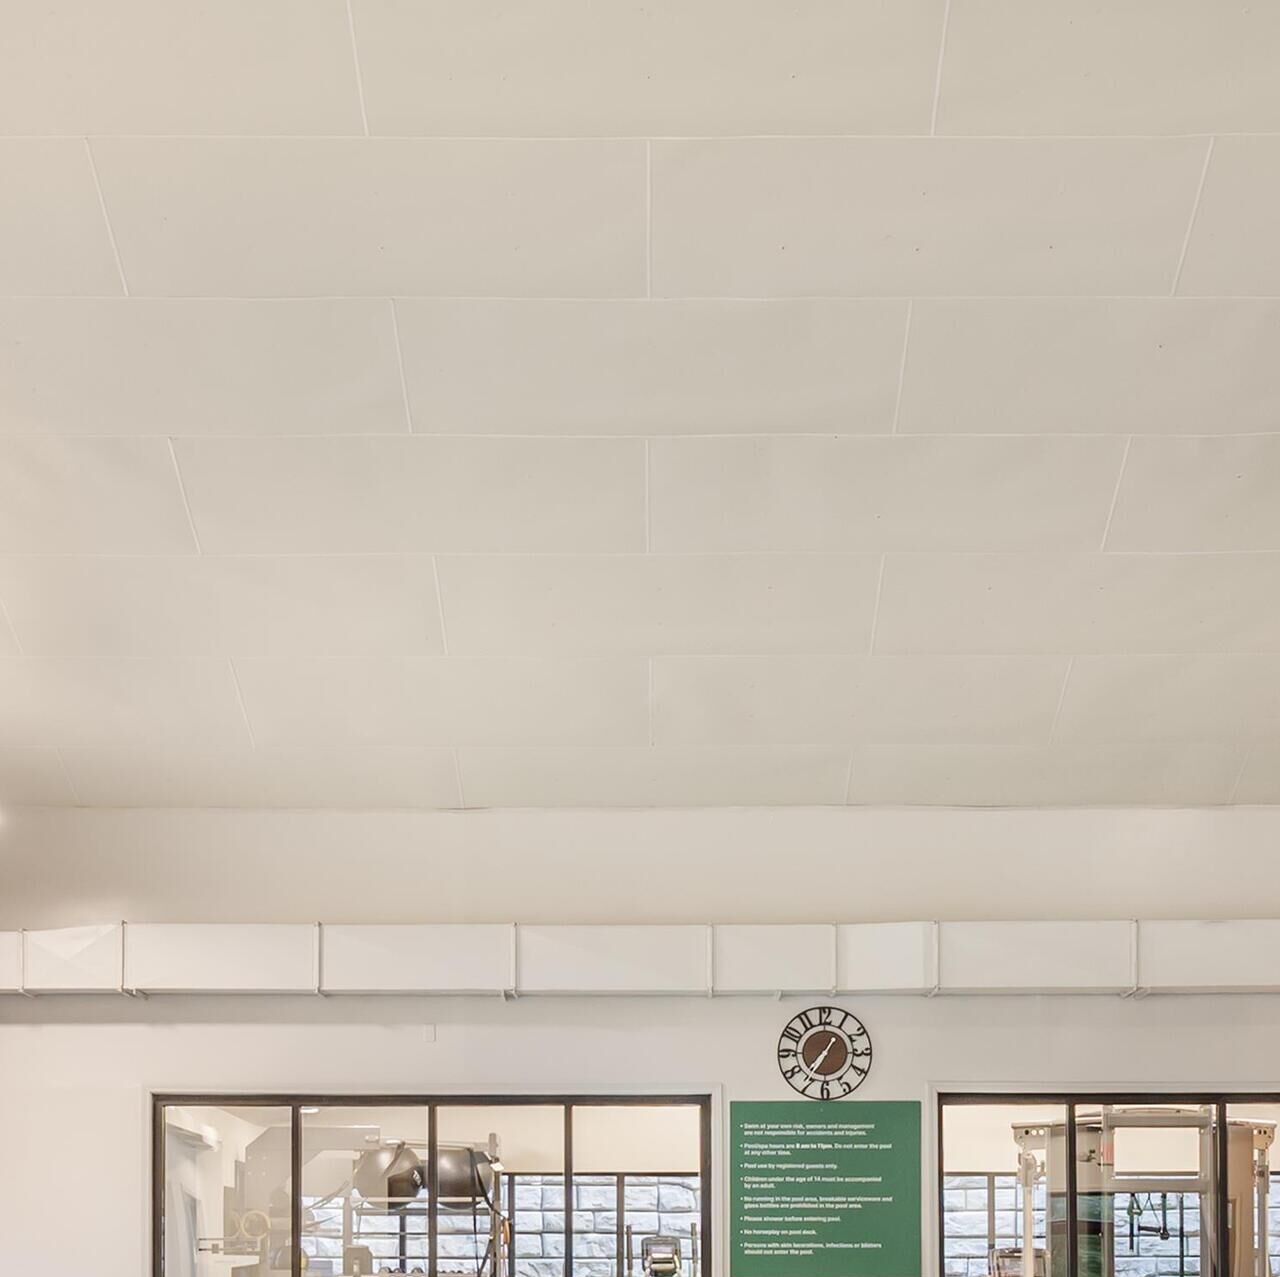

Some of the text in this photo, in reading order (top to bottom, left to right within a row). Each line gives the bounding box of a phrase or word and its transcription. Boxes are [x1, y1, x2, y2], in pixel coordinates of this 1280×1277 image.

[799, 1013, 813, 1030] 11
[819, 1008, 832, 1025] 12
[784, 1027, 801, 1042] 10
[849, 1027, 864, 1042] 2
[779, 1049, 796, 1058] 9
[853, 1048, 871, 1056] 3
[784, 1065, 801, 1079] 8
[851, 1064, 865, 1076] 4
[821, 1082, 829, 1099] 6
[837, 1076, 851, 1093] 5
